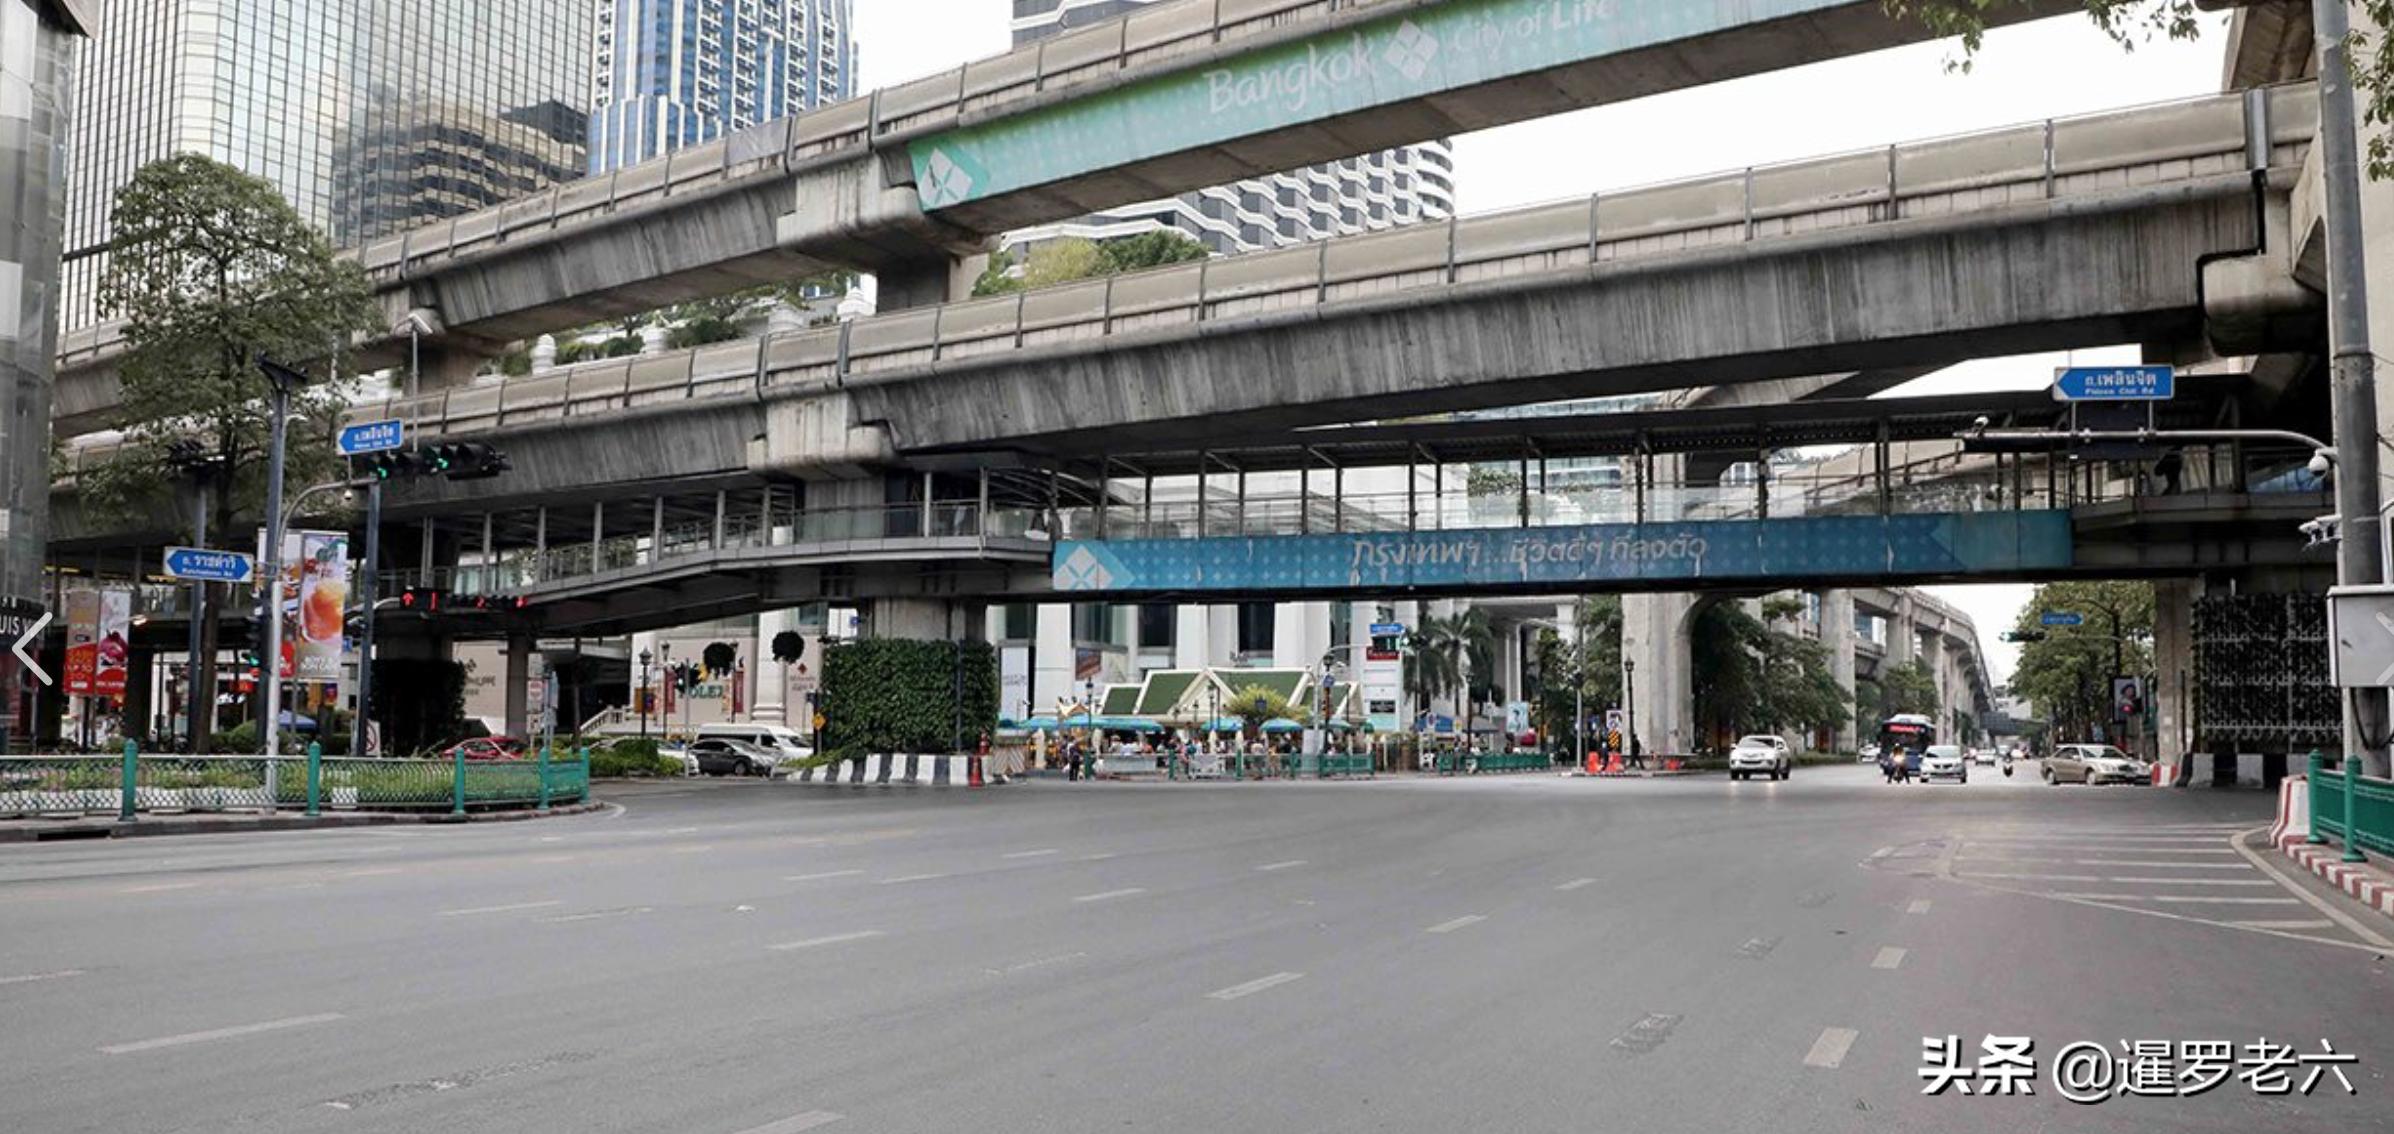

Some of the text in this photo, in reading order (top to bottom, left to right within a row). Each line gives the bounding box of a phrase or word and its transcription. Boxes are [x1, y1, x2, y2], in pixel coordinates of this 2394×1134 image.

[1203, 32, 1377, 114] Bangkok
[1455, 10, 1506, 61] City
[1516, 4, 1547, 38] of
